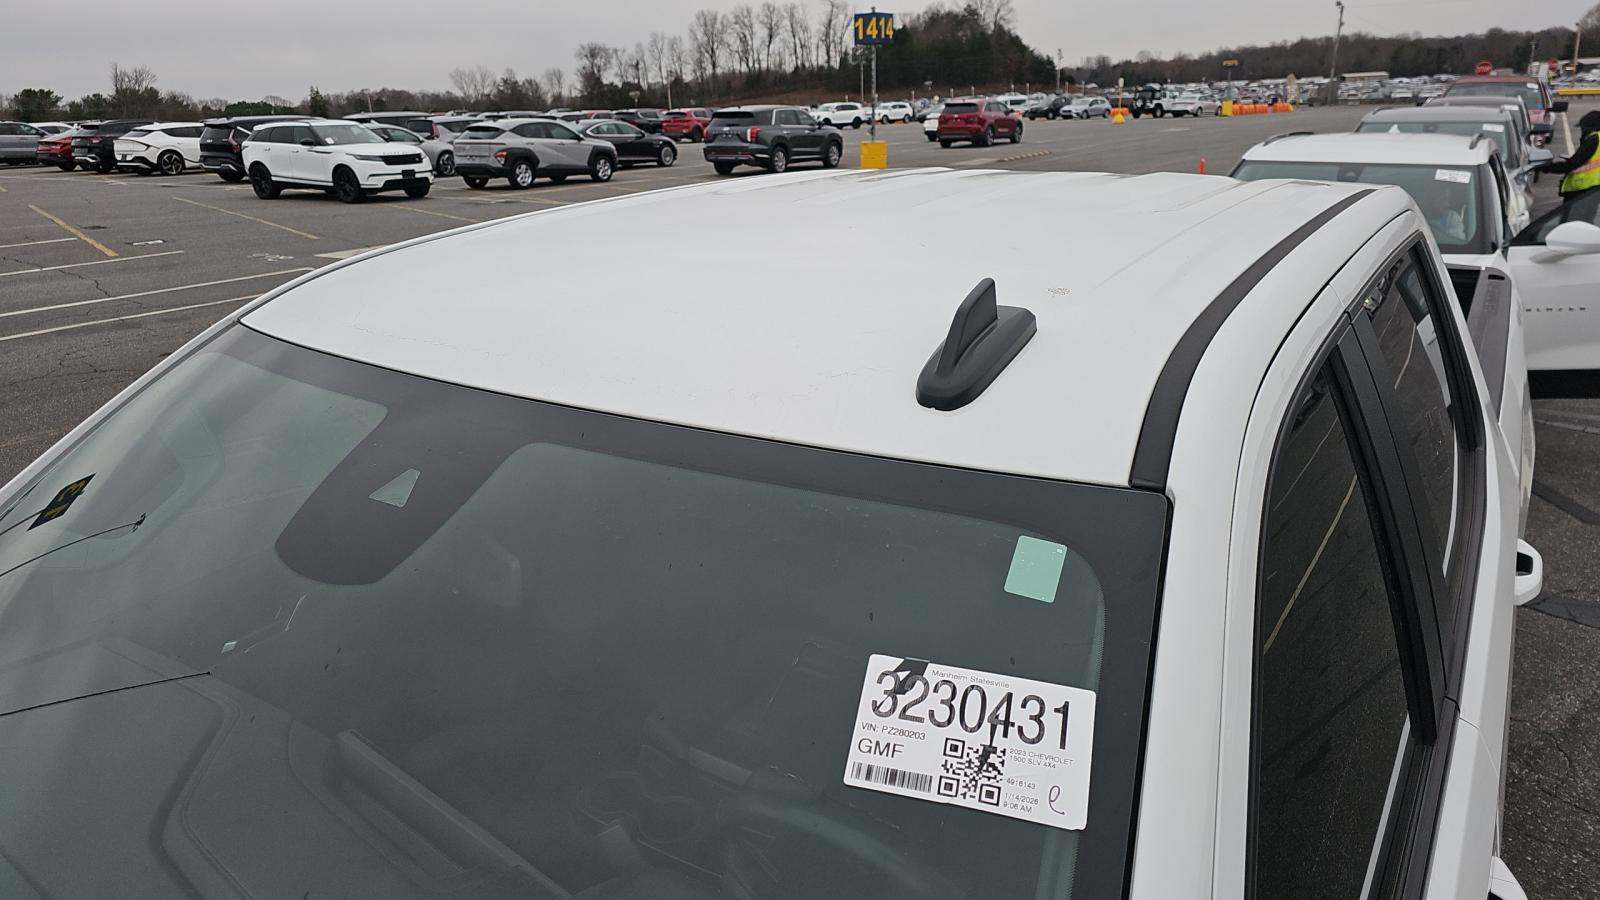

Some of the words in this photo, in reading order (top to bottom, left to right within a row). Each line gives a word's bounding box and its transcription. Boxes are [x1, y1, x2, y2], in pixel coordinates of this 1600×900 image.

[855, 16, 894, 40] 1414
[932, 669, 968, 683] Manheim
[970, 676, 1010, 688] Statesville
[871, 669, 1070, 750] 3230431
[861, 721, 879, 732] VIN:
[881, 725, 926, 740] PZ280203
[858, 738, 905, 758] GMF
[1009, 748, 1027, 756] 2023
[1028, 752, 1074, 766] CHEVROLET
[1010, 755, 1026, 764] 1500
[1004, 792, 1039, 805] 1/14/2026
[1020, 804, 1033, 814] AM
